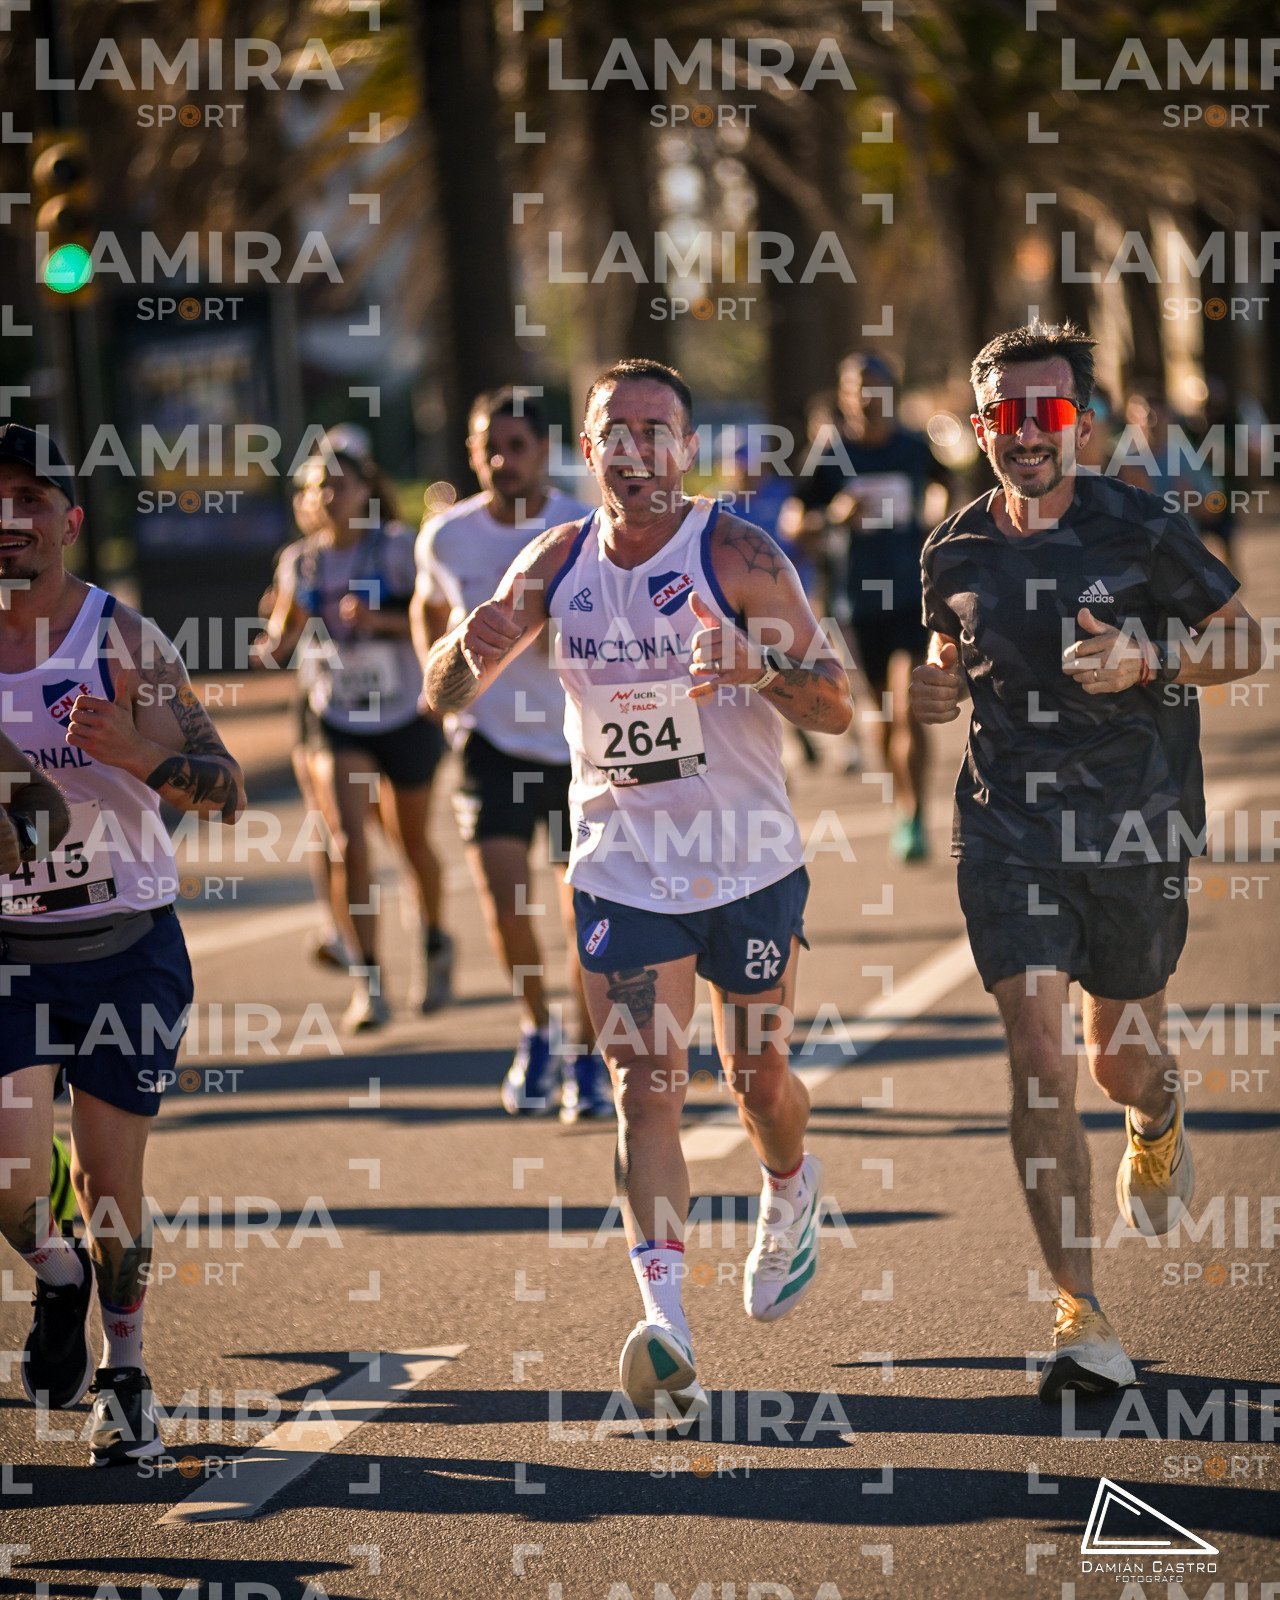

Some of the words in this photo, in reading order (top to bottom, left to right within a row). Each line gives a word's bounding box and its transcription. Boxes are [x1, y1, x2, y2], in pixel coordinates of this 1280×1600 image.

[1078, 594, 1115, 603] adidas
[569, 633, 693, 662] NACIONAL
[632, 703, 658, 711] FALCK
[601, 716, 681, 759] 264
